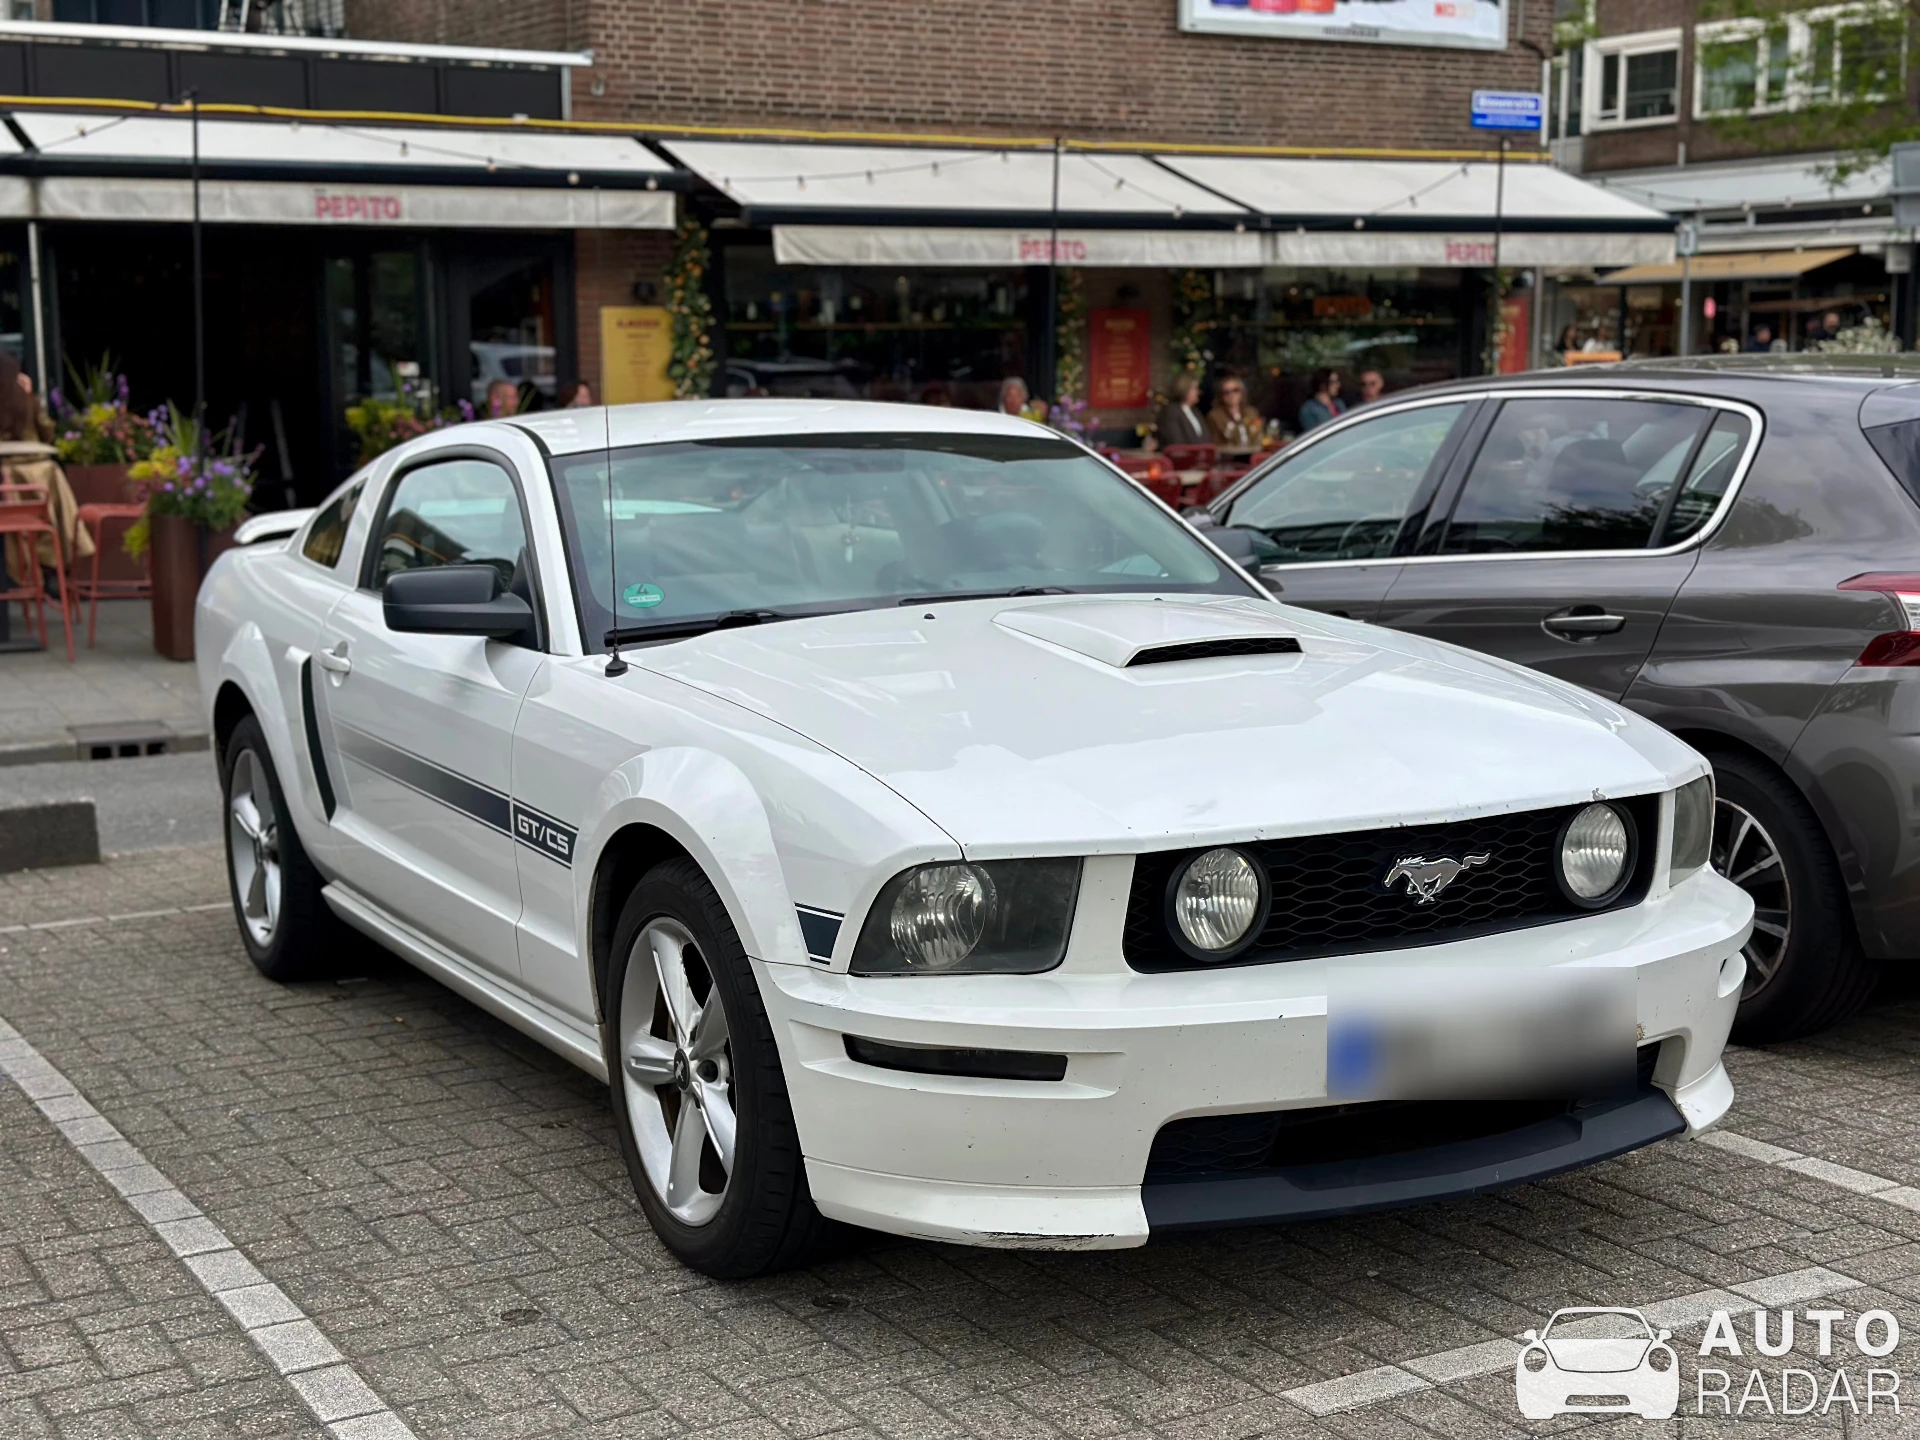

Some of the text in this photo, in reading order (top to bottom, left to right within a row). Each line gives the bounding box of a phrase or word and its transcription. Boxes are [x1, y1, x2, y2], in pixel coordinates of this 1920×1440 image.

[315, 195, 401, 219] PEPITO
[1020, 240, 1087, 260] PEPITO
[637, 583, 649, 596] 4
[517, 813, 569, 855] GT/CS
